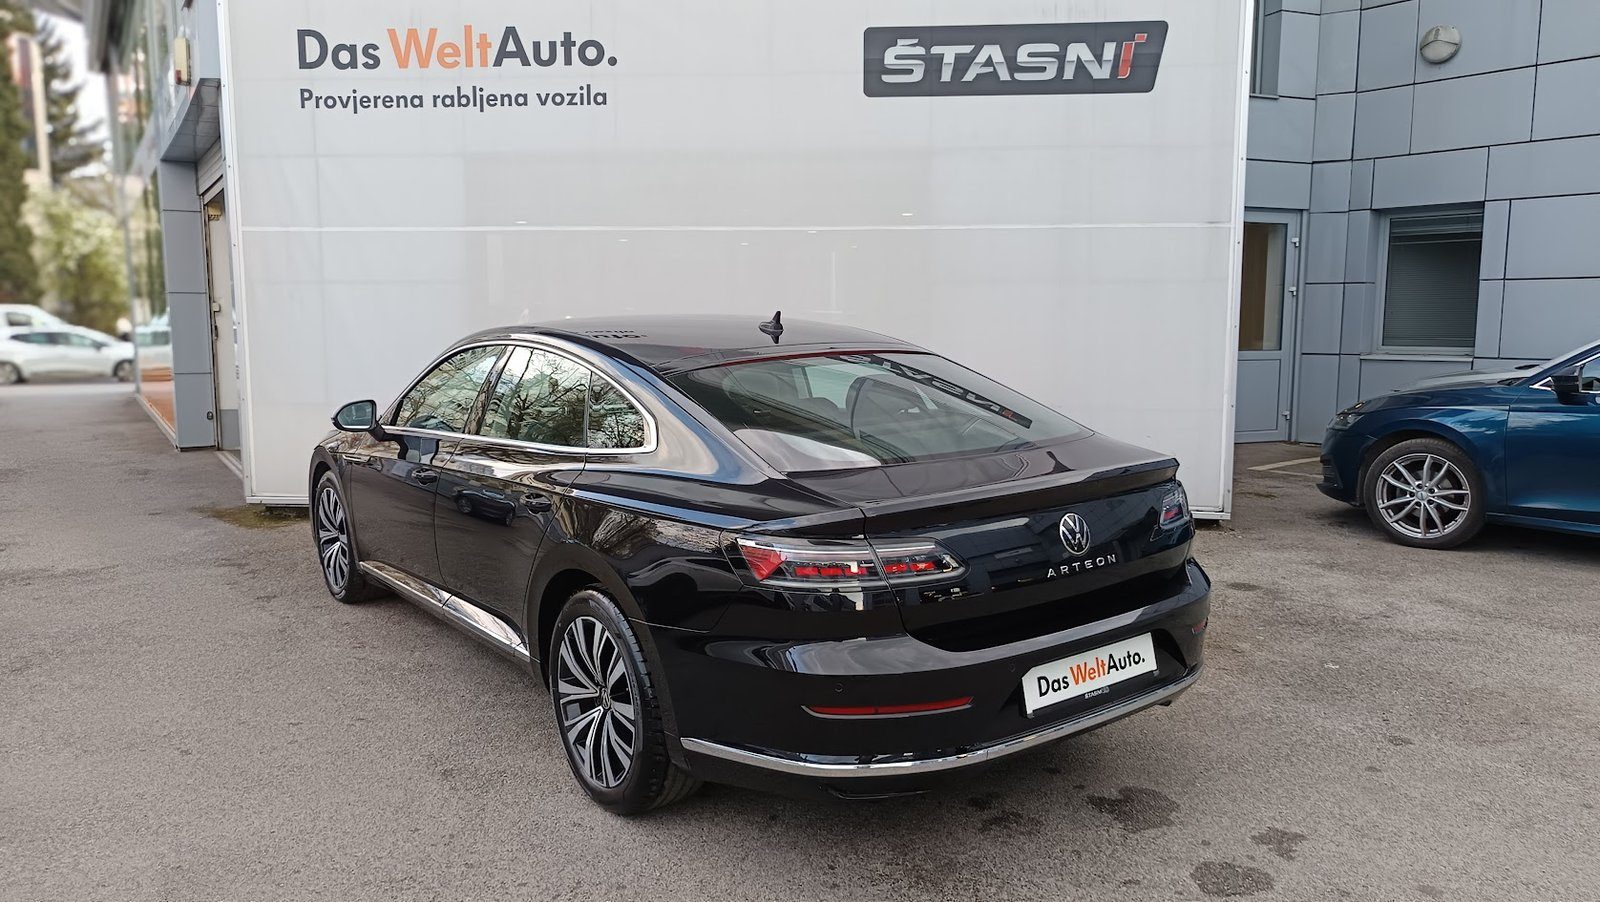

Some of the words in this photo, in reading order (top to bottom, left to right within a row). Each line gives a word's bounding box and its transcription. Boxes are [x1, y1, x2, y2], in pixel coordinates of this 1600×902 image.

[296, 28, 381, 70] Das
[386, 24, 618, 69] WeltAuto.
[299, 87, 424, 114] Provjerena
[431, 85, 529, 113] rabljena
[536, 83, 608, 107] vozila
[1047, 554, 1117, 578] ARTEON
[1036, 675, 1070, 697] Das
[1069, 650, 1146, 686] WeltAuto.
